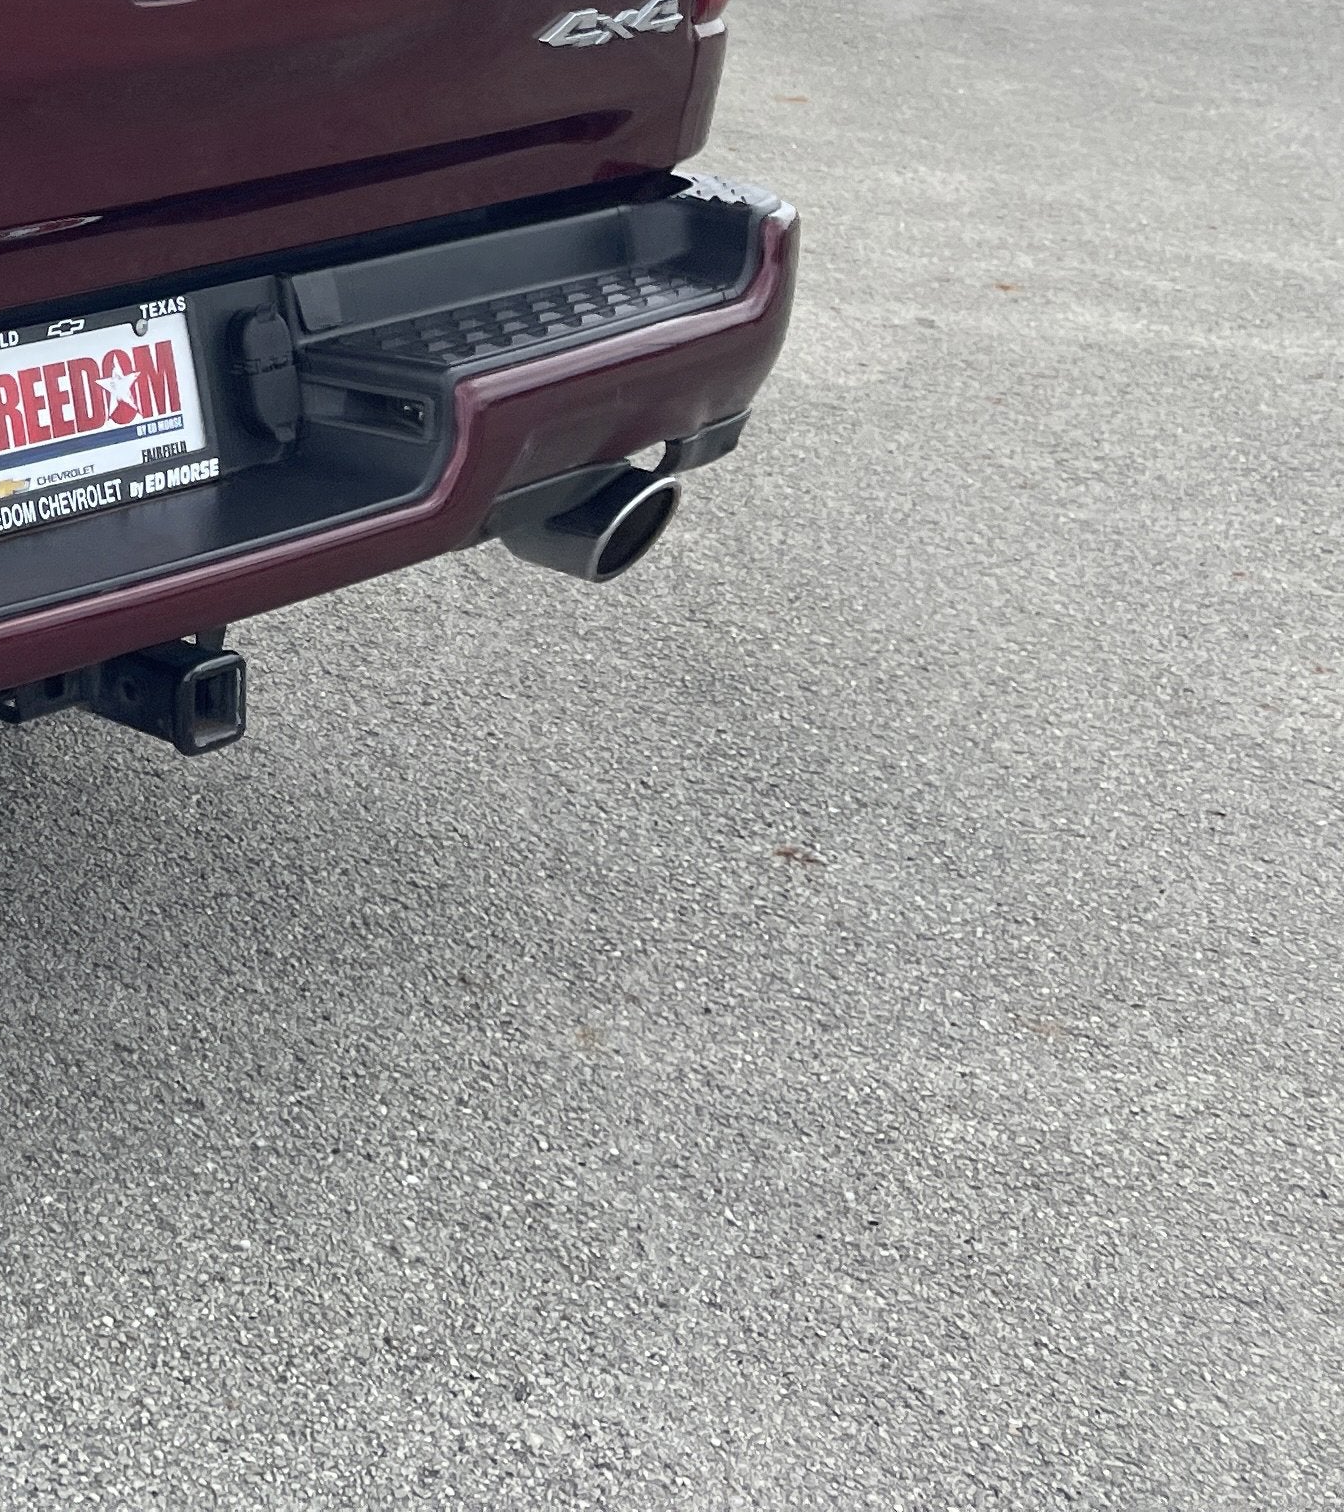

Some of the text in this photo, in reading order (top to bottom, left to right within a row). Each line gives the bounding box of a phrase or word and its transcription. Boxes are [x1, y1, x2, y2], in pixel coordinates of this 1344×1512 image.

[139, 296, 187, 320] TEXAS
[141, 440, 188, 464] FAIRFIELD
[36, 464, 95, 486] CHEVROLET
[38, 478, 123, 520] CHEVROLET
[144, 471, 166, 494] ED
[167, 457, 220, 489] MORSE
